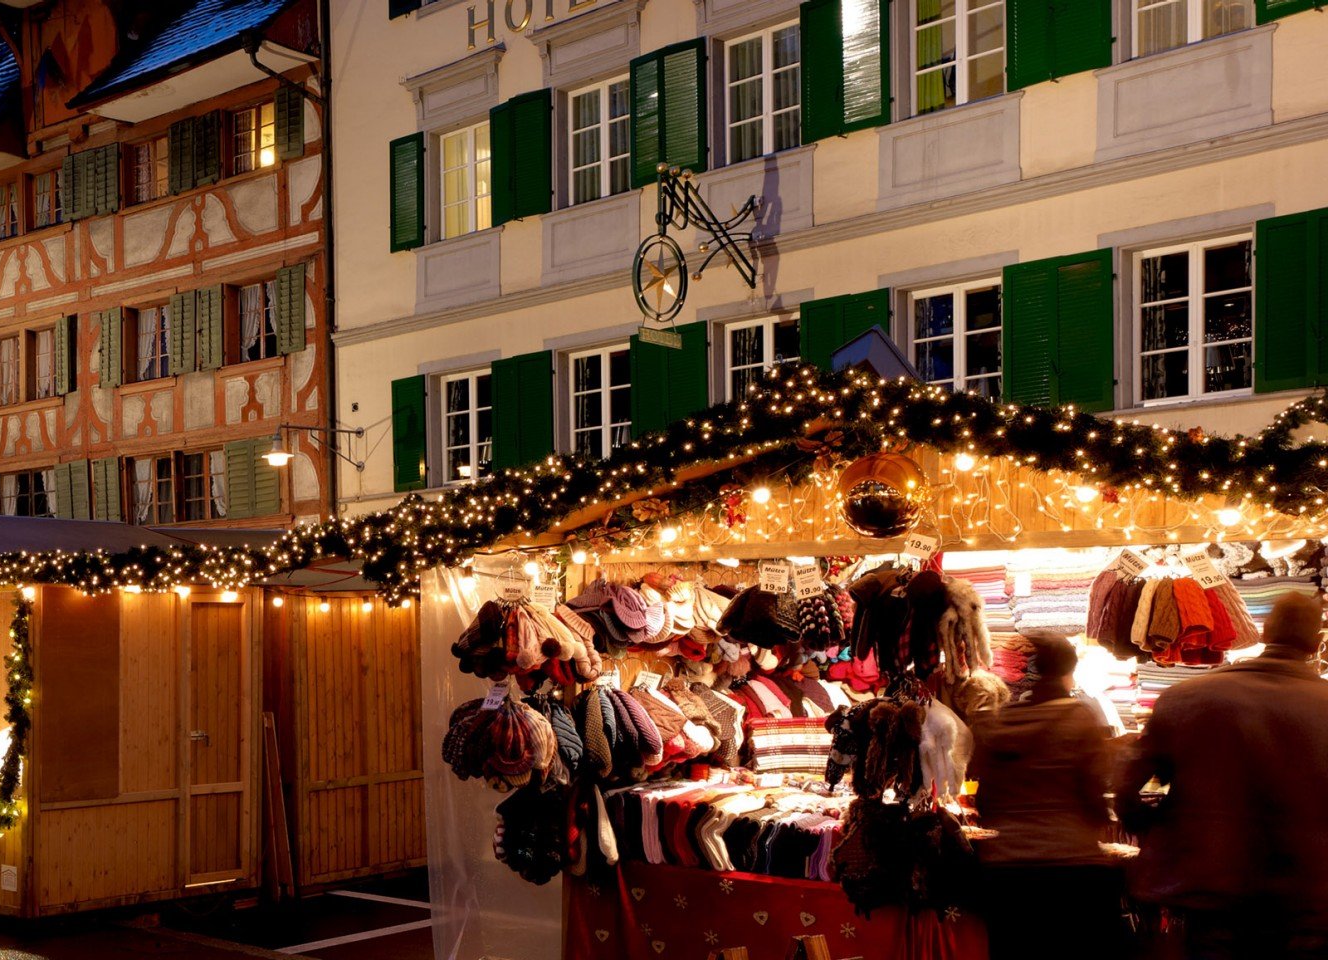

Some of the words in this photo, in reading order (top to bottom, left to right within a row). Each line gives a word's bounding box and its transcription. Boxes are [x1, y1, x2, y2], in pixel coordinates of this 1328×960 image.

[910, 540, 932, 551] 19.90
[796, 566, 817, 576] Mütze
[764, 583, 786, 592] 19.90
